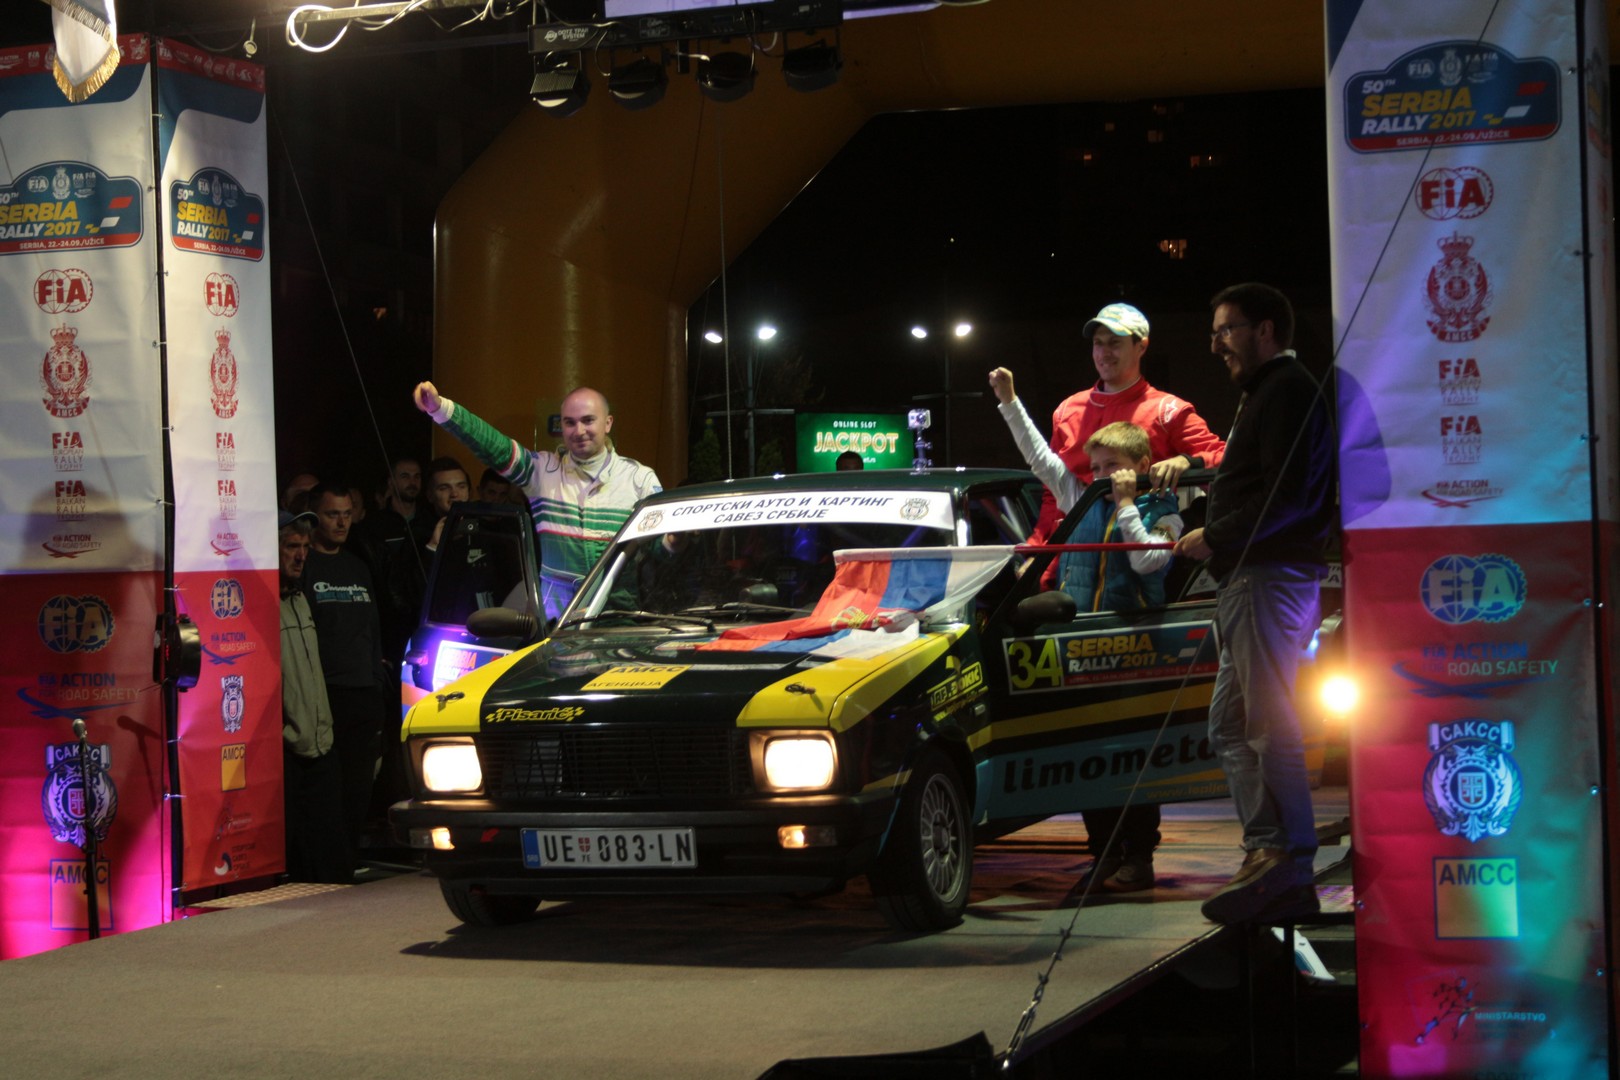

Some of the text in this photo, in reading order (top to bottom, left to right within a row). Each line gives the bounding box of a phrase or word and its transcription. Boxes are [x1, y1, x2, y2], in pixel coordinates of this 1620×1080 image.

[1360, 86, 1473, 118] SERBIA
[1360, 110, 1477, 136] RALLY 2017
[177, 188, 194, 200] 50TH
[176, 200, 228, 227] SERBIA
[44, 220, 82, 237] 2017
[177, 221, 230, 241] RALLY 2017
[860, 420, 877, 429] SLOT
[813, 431, 899, 454] JACKPOT
[54, 455, 83, 464] RALLY
[1451, 479, 1489, 488] ACTION
[56, 504, 86, 513] RALLY
[672, 495, 896, 518] СПОРТСКИ АУТО И КАРТИНГ
[713, 508, 830, 525] САВЕЗ СРБИЈЕ
[64, 533, 91, 542] ACTION
[221, 631, 246, 642] ACTION
[237, 642, 257, 652] SAFETY
[1066, 633, 1154, 659] SERBIA
[1453, 641, 1528, 659] ACTION
[1008, 637, 1064, 690] 34
[1068, 652, 1158, 674] RALLY 2017
[1447, 661, 1493, 676] ROAD
[1495, 659, 1559, 676] SAFETY
[60, 672, 116, 687] ACTION
[57, 688, 90, 701] ROAD
[92, 687, 141, 701] SAFETY
[543, 834, 576, 863] UE
